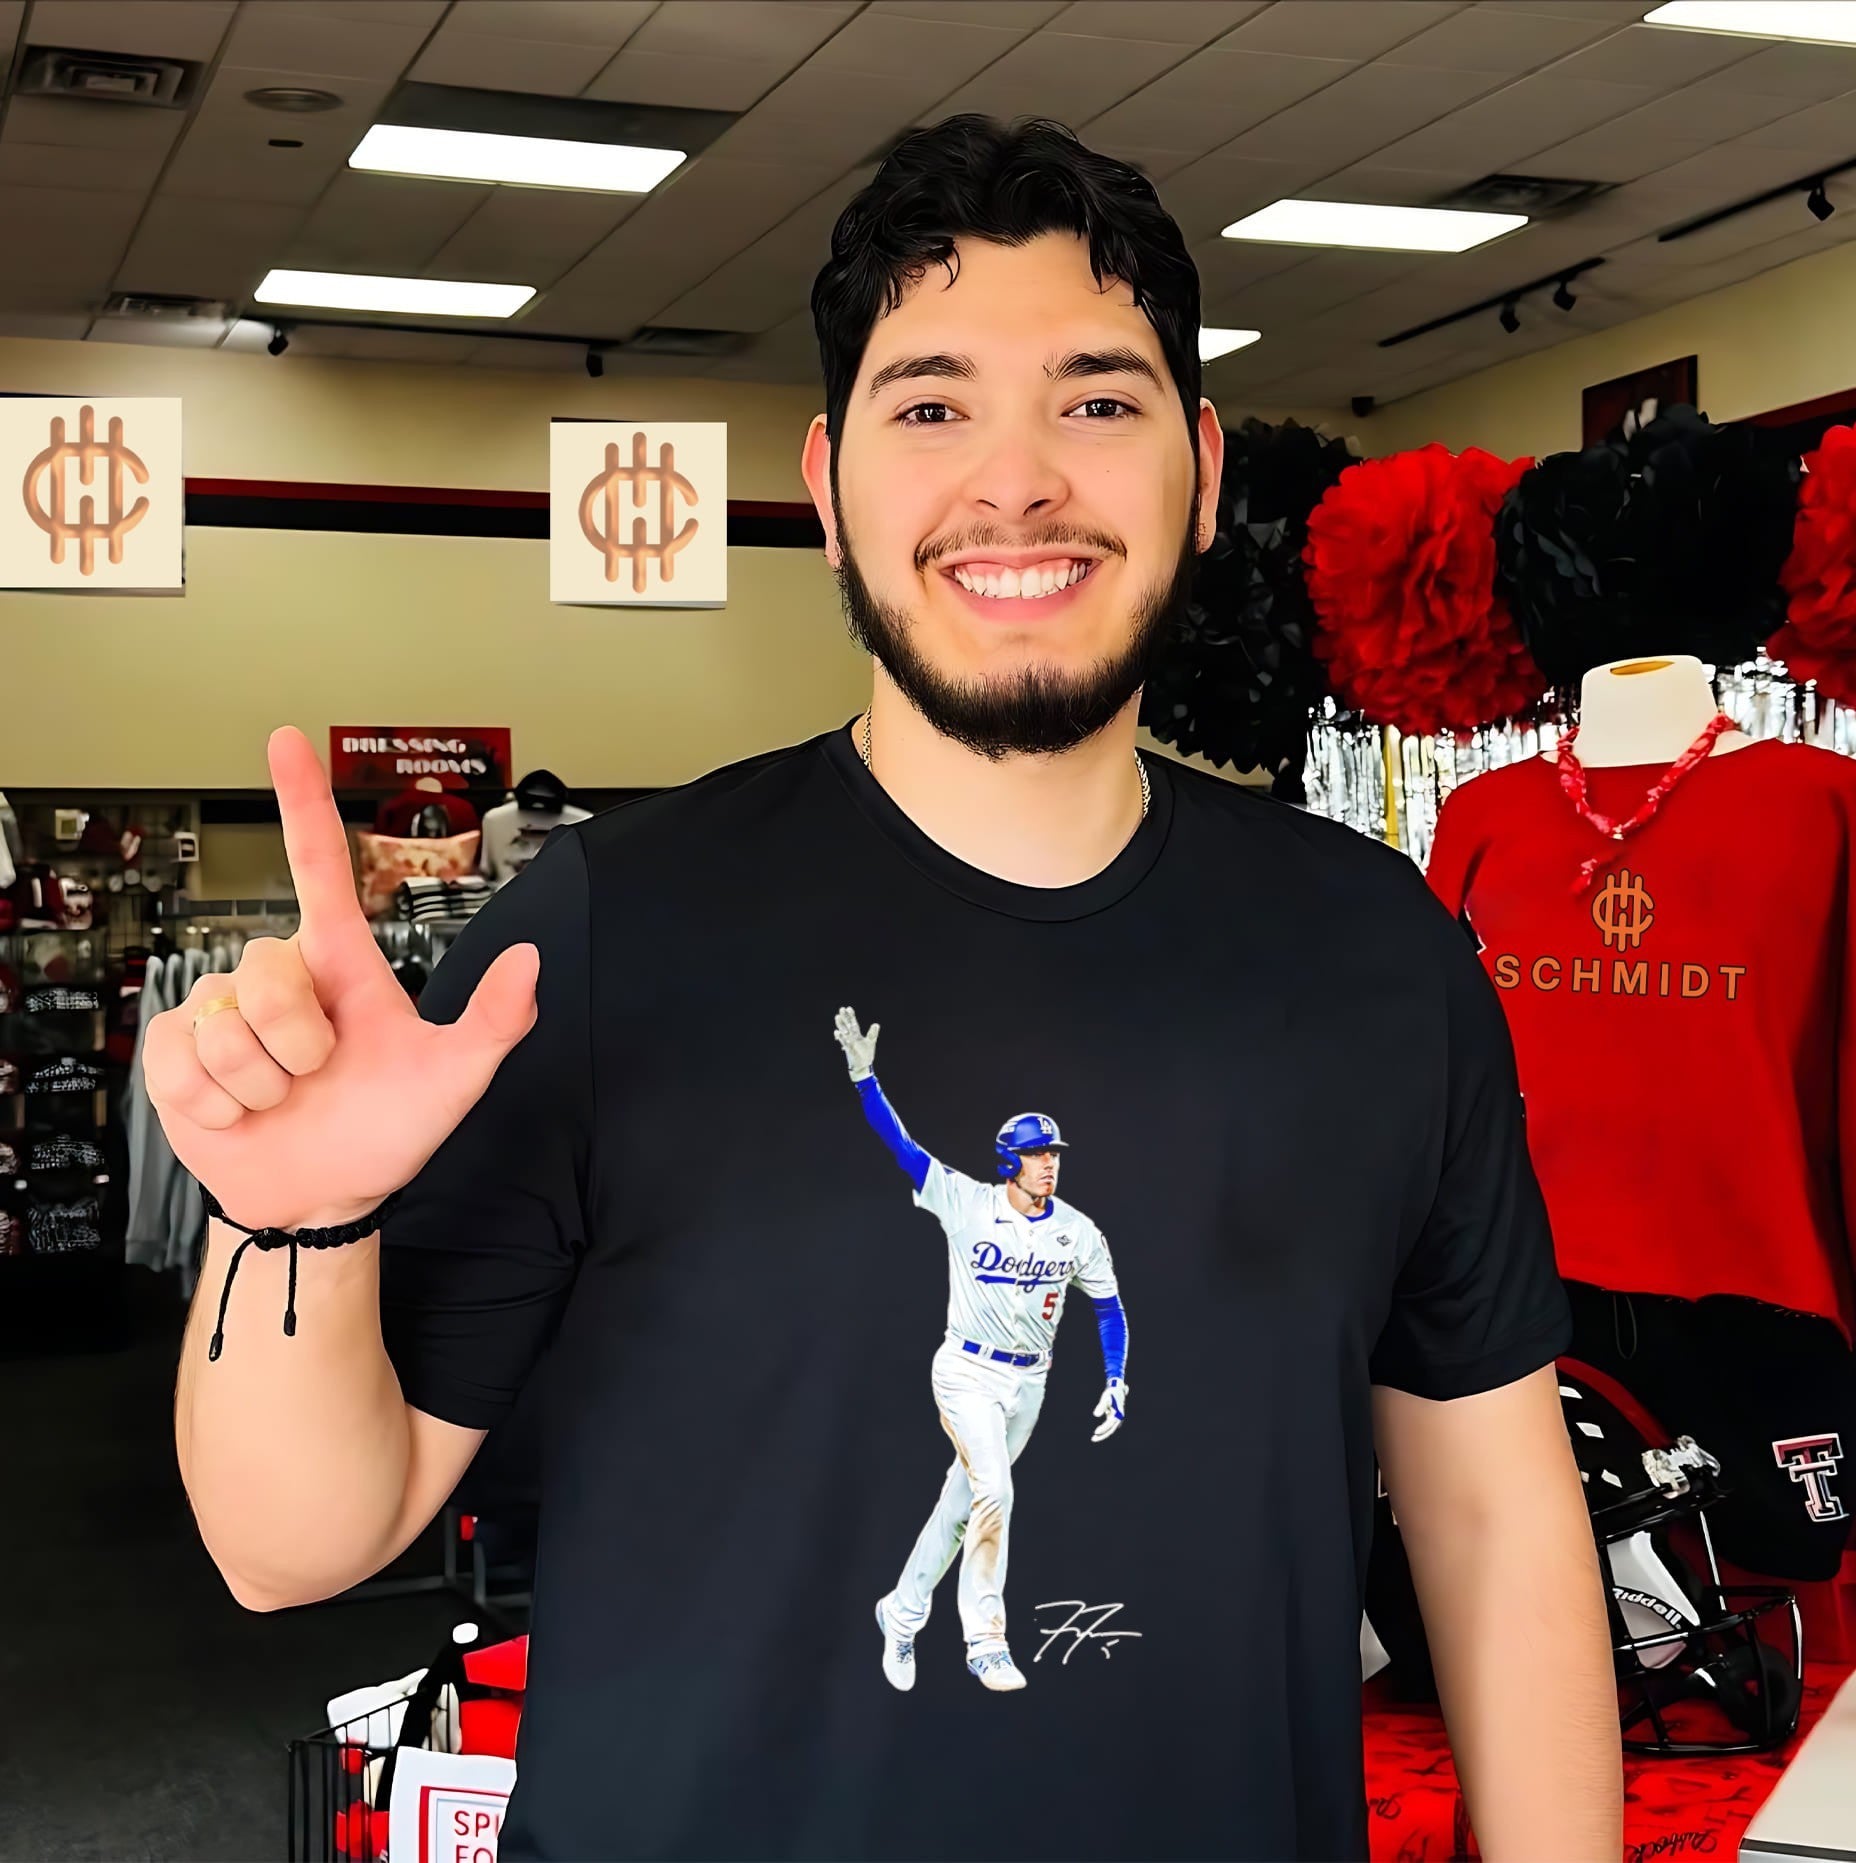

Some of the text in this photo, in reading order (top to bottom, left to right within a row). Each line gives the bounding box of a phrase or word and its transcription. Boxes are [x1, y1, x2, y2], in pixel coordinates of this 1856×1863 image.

[342, 737, 466, 753] DRESSING
[396, 758, 487, 774] ROOMS
[1494, 954, 1747, 1000] SCHMIDT
[970, 1241, 1078, 1293] Dodgers
[1041, 1292, 1059, 1321] 5
